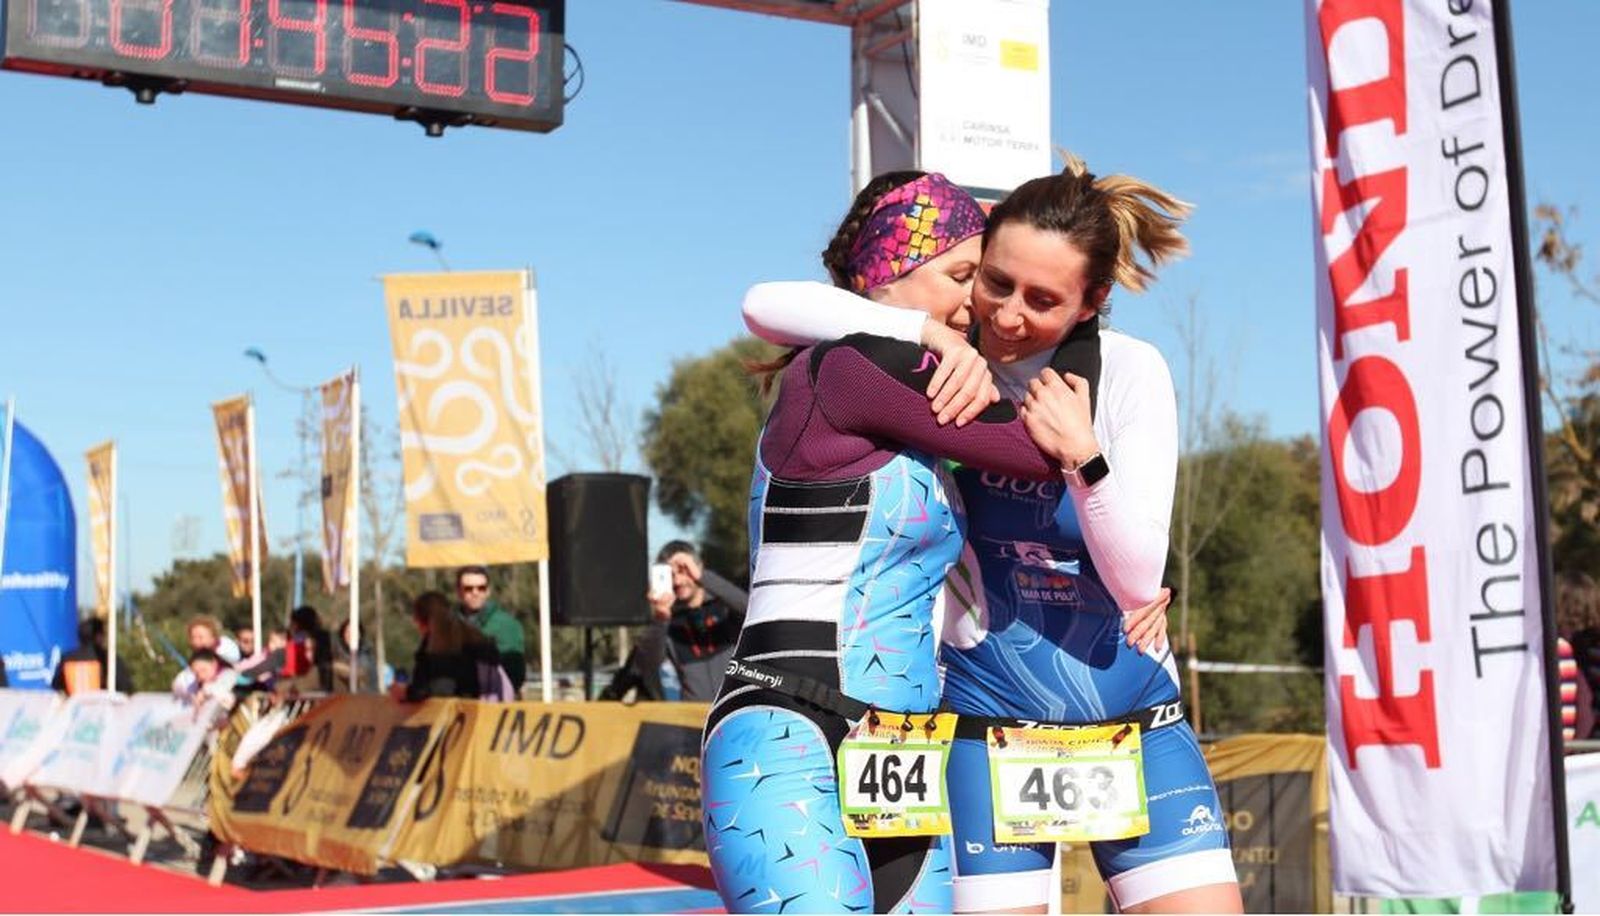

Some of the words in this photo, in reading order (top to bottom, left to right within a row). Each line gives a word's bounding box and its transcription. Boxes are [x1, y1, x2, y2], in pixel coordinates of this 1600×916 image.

[1440, 135, 1489, 212] of
[1457, 234, 1511, 495] Power
[1469, 522, 1529, 679] The
[489, 708, 587, 760] IMD
[858, 753, 928, 803] 464
[1018, 765, 1117, 812] 463
